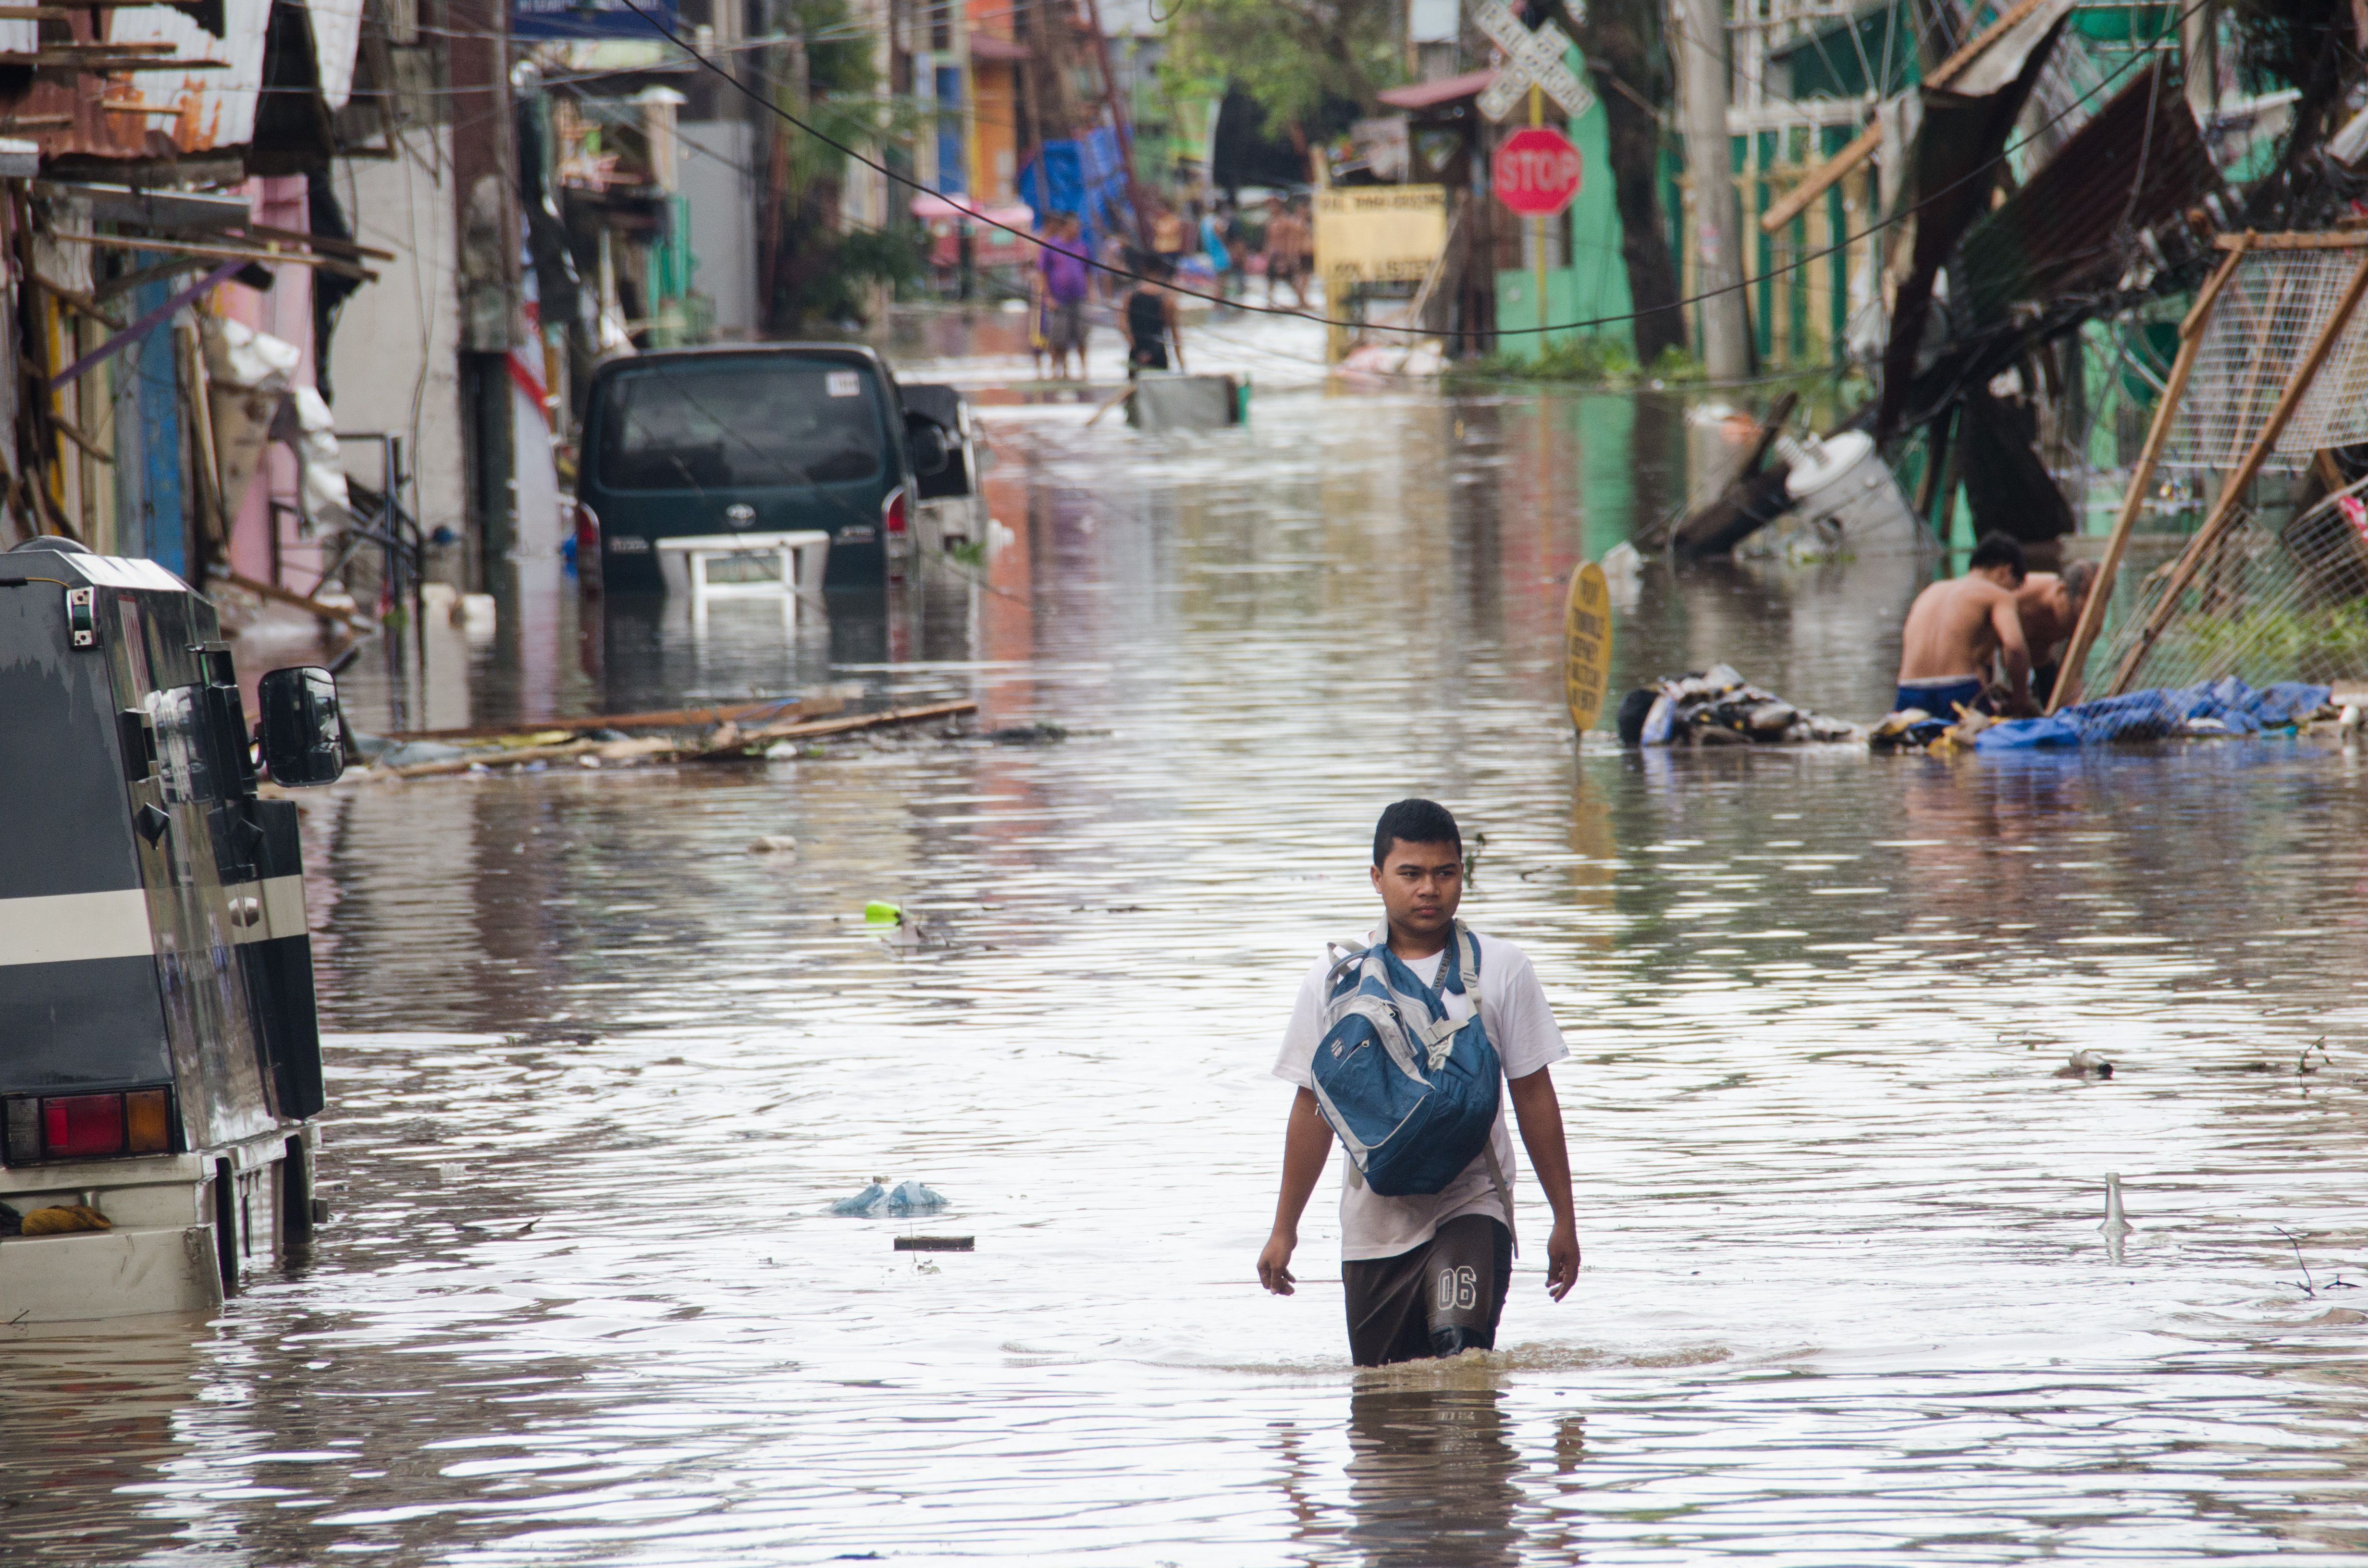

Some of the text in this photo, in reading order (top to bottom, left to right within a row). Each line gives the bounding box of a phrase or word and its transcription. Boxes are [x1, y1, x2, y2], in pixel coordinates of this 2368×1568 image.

[1498, 151, 1578, 192] STOP
[1434, 953, 1451, 988] PETER
[1438, 1265, 1477, 1311] 06
